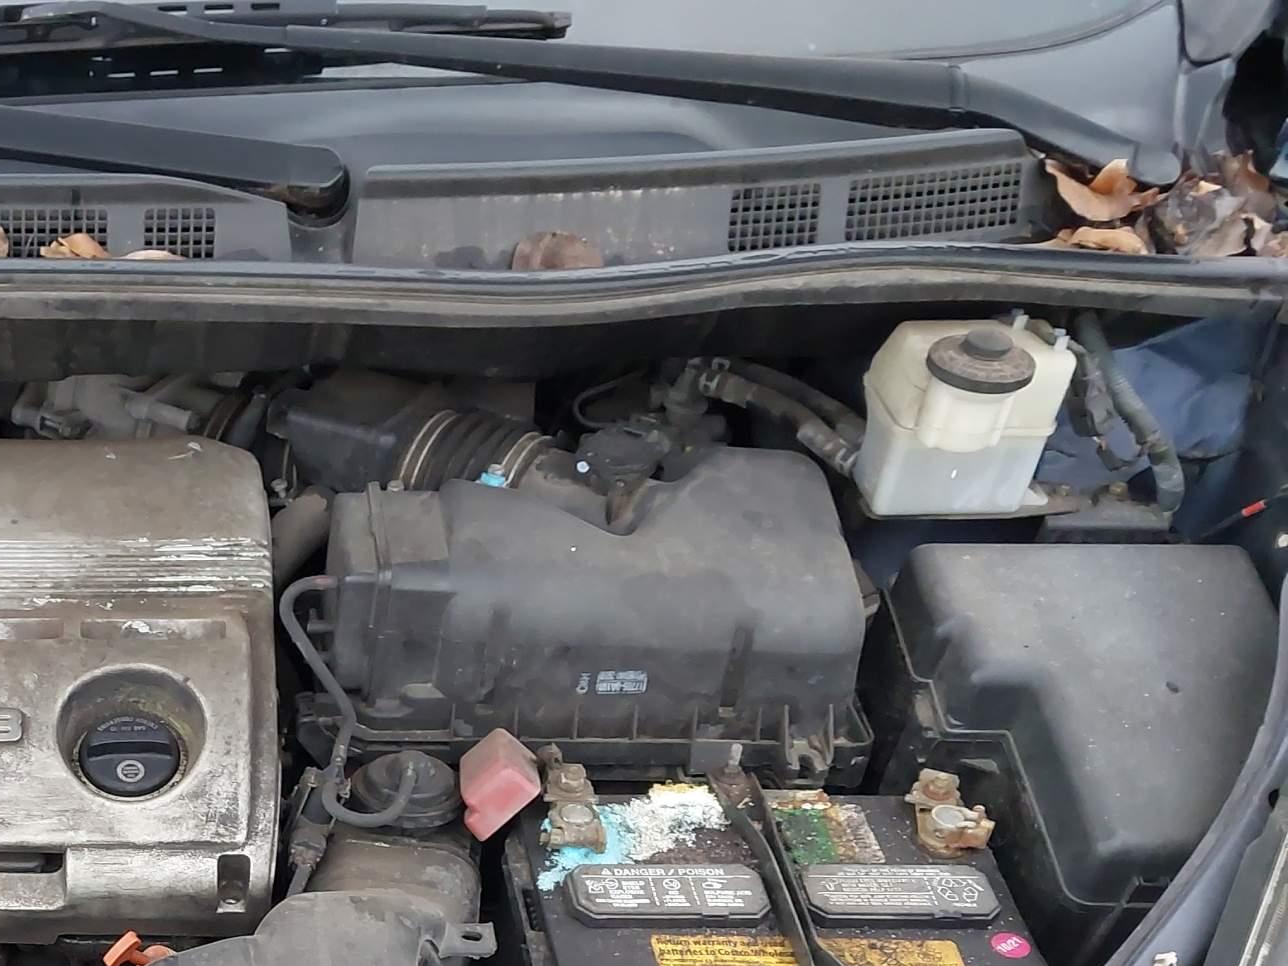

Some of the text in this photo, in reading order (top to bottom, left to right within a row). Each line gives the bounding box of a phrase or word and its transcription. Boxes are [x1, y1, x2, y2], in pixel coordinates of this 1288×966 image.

[613, 868, 665, 876] DANGER
[677, 868, 725, 876] POISON
[656, 937, 690, 946] Return
[692, 938, 737, 948] warranty
[997, 937, 1023, 953] 10/21
[658, 946, 703, 958] batteries
[705, 948, 716, 956] to
[718, 948, 750, 957] Costco
